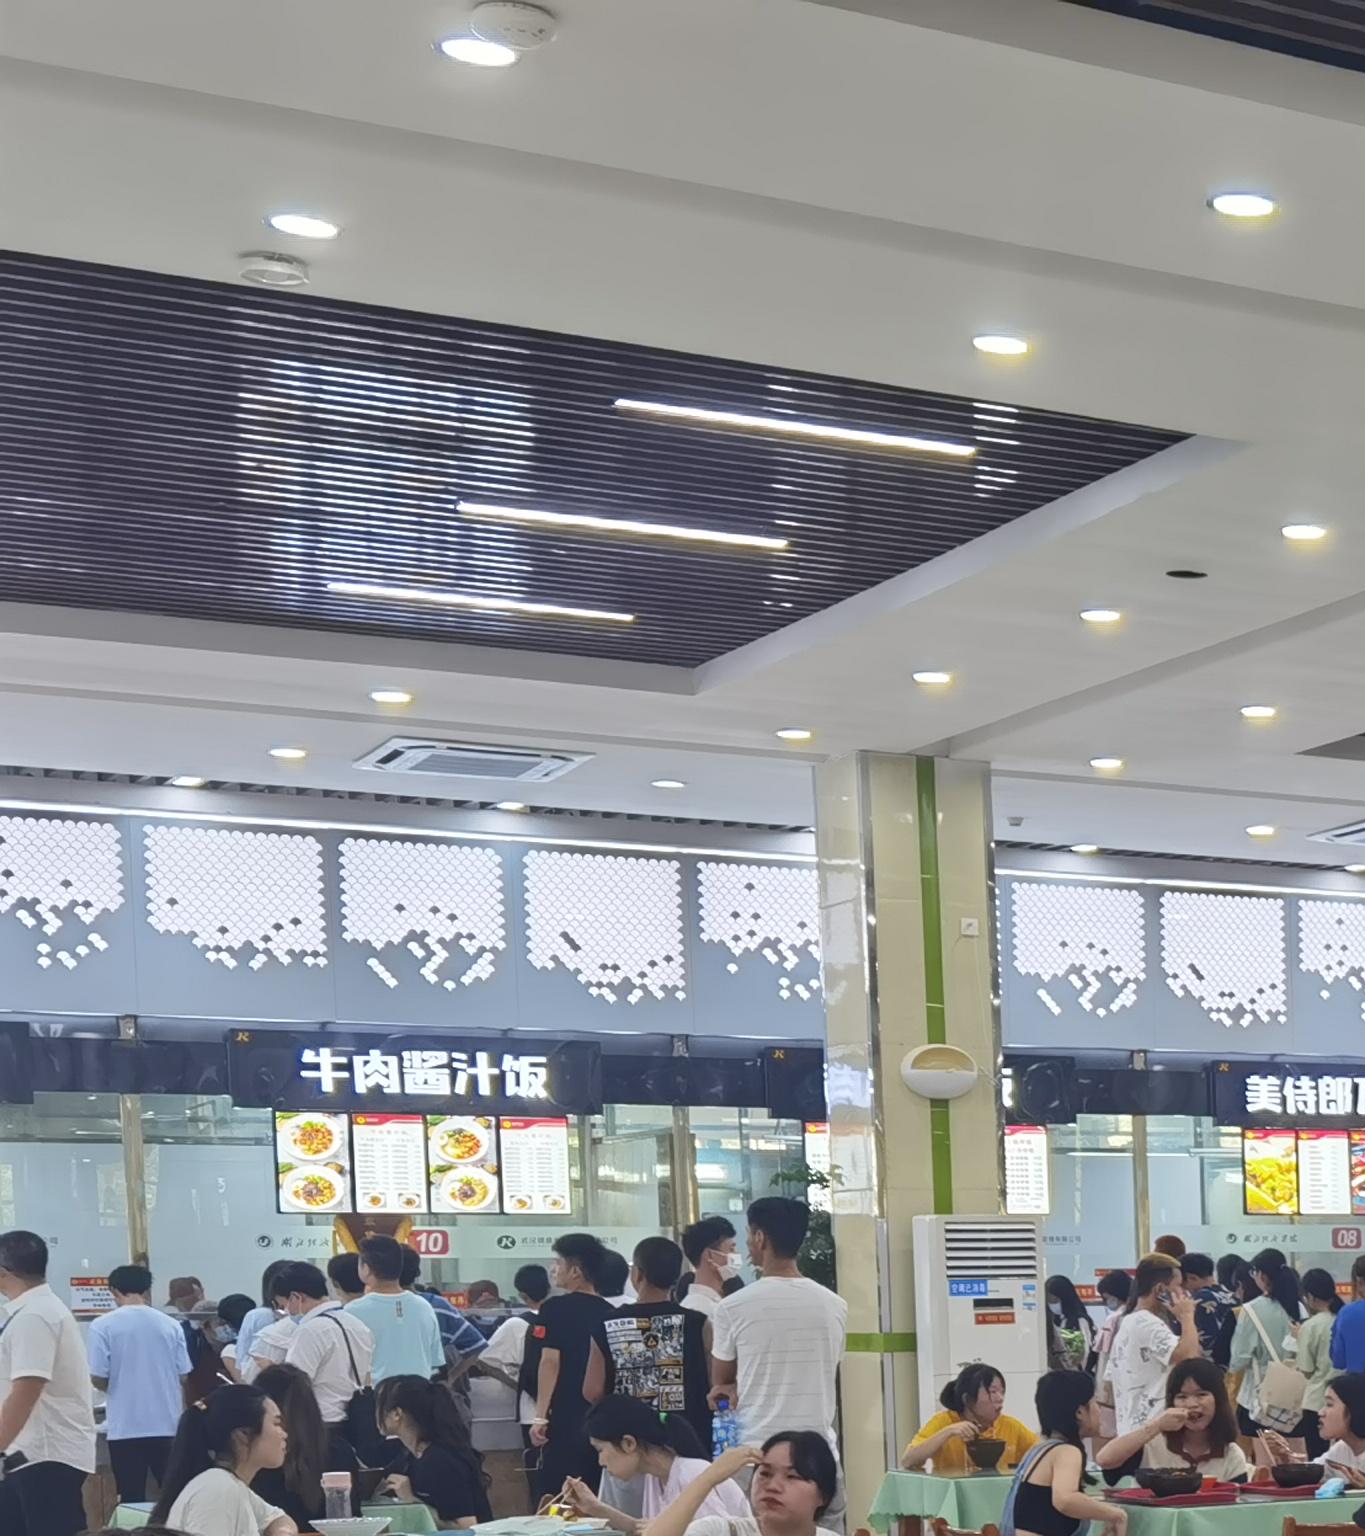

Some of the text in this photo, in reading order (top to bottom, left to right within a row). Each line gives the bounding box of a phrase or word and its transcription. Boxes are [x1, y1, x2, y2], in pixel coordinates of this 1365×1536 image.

[300, 1047, 549, 1099] 牛肉酱汁饭
[416, 1231, 443, 1254] 10
[1336, 1230, 1357, 1247] 08
